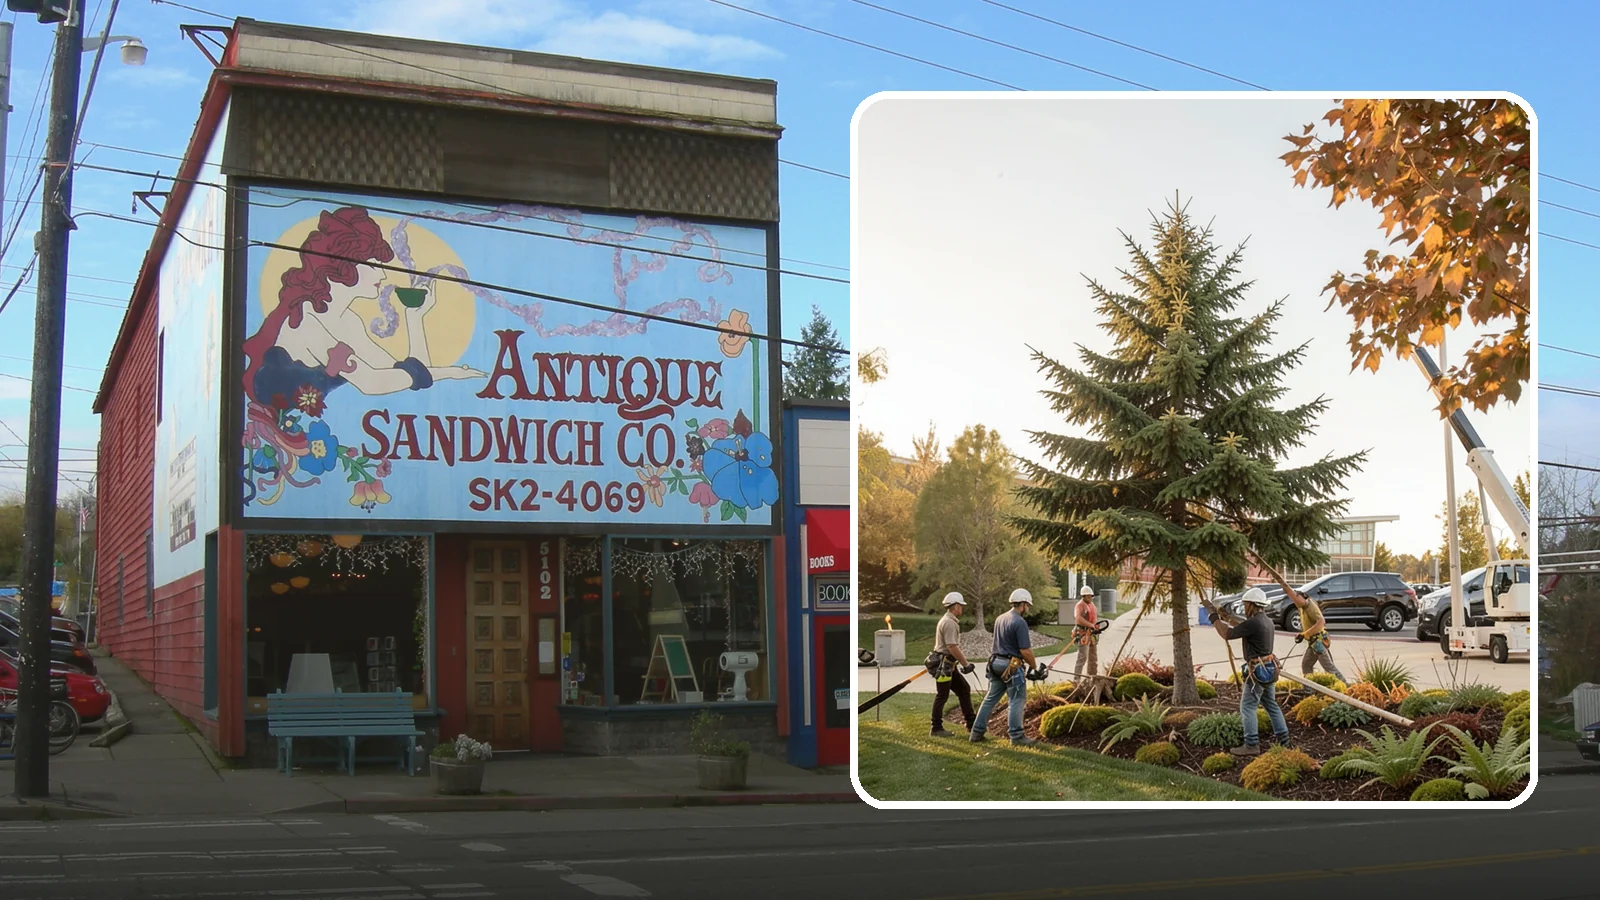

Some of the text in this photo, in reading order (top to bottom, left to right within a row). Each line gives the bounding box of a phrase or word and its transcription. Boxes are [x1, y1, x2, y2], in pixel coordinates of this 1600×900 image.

[475, 329, 723, 421] ANTIQUE
[361, 408, 685, 469] SANDWICH CO.
[468, 476, 646, 513] SK2-4069
[539, 541, 552, 600] 5102
[809, 555, 835, 569] BOOKS
